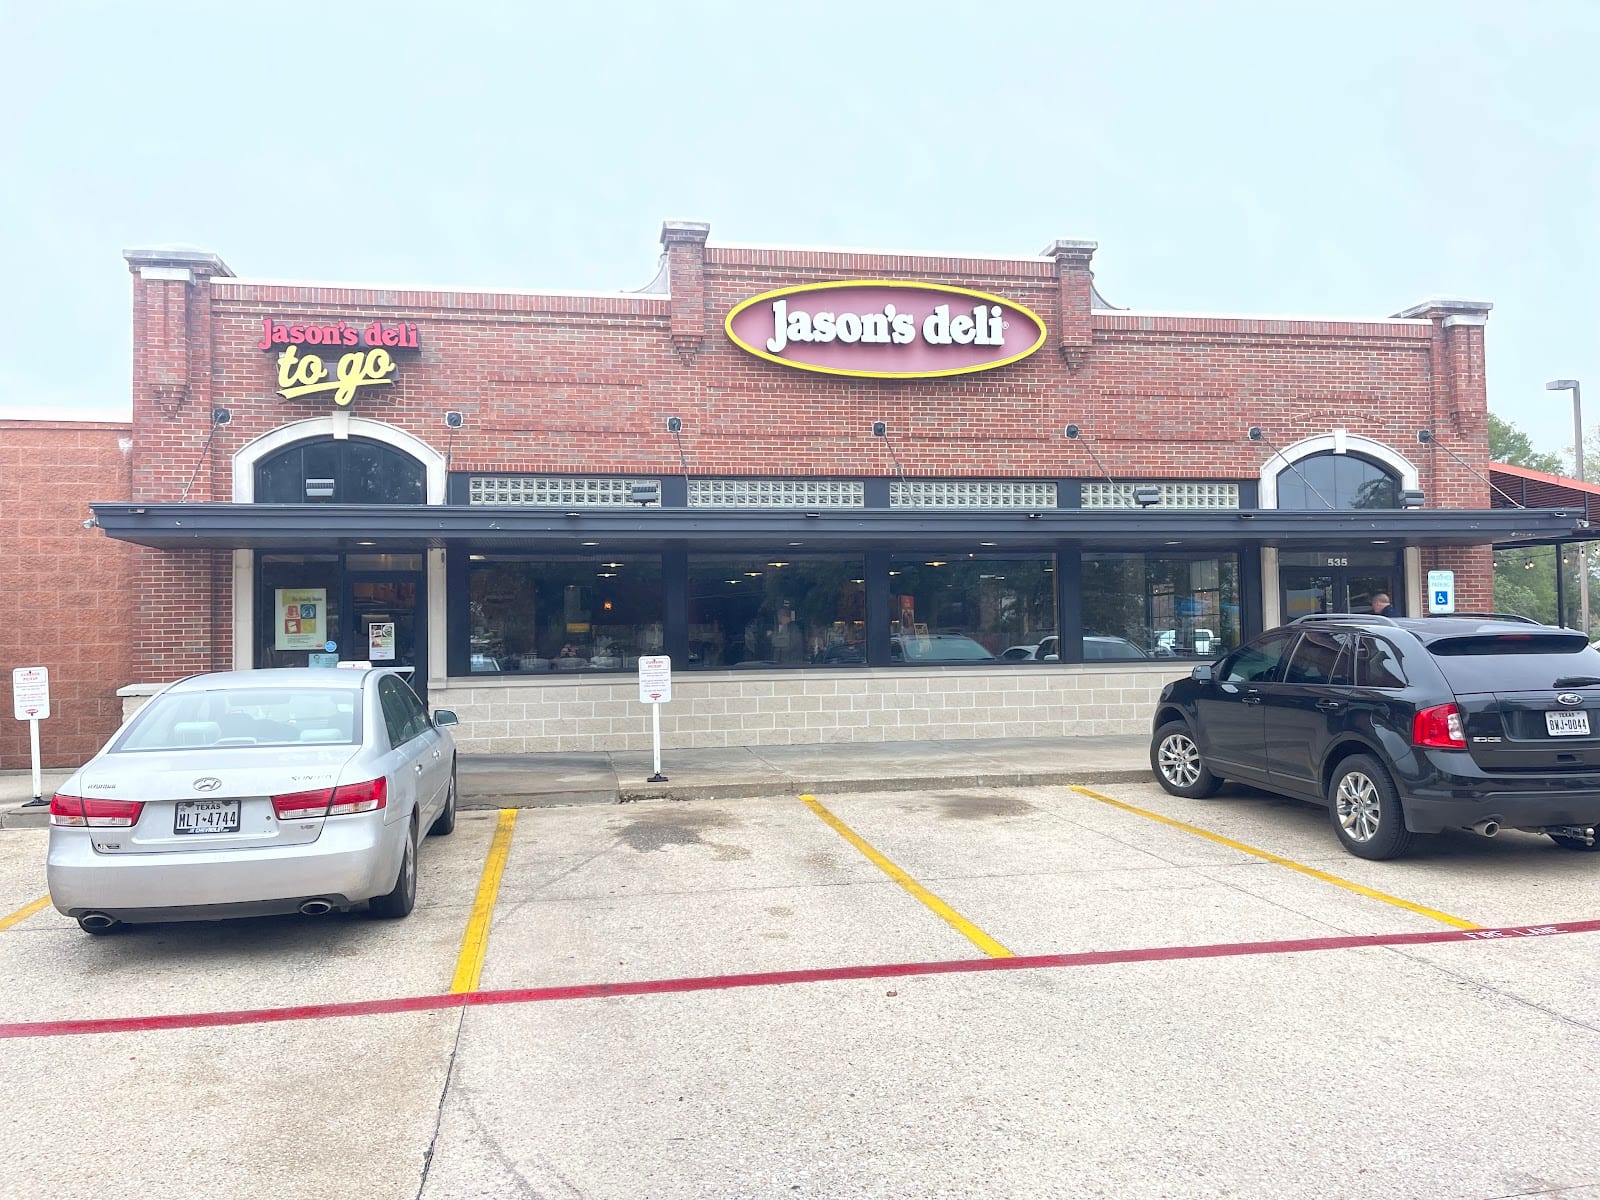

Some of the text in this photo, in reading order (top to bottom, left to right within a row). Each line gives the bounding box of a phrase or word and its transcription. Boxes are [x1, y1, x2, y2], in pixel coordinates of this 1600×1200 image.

[258, 318, 419, 350] Jason's deli
[766, 299, 1005, 353] Jason's deli
[278, 345, 396, 406] to go
[1327, 558, 1348, 567] 535
